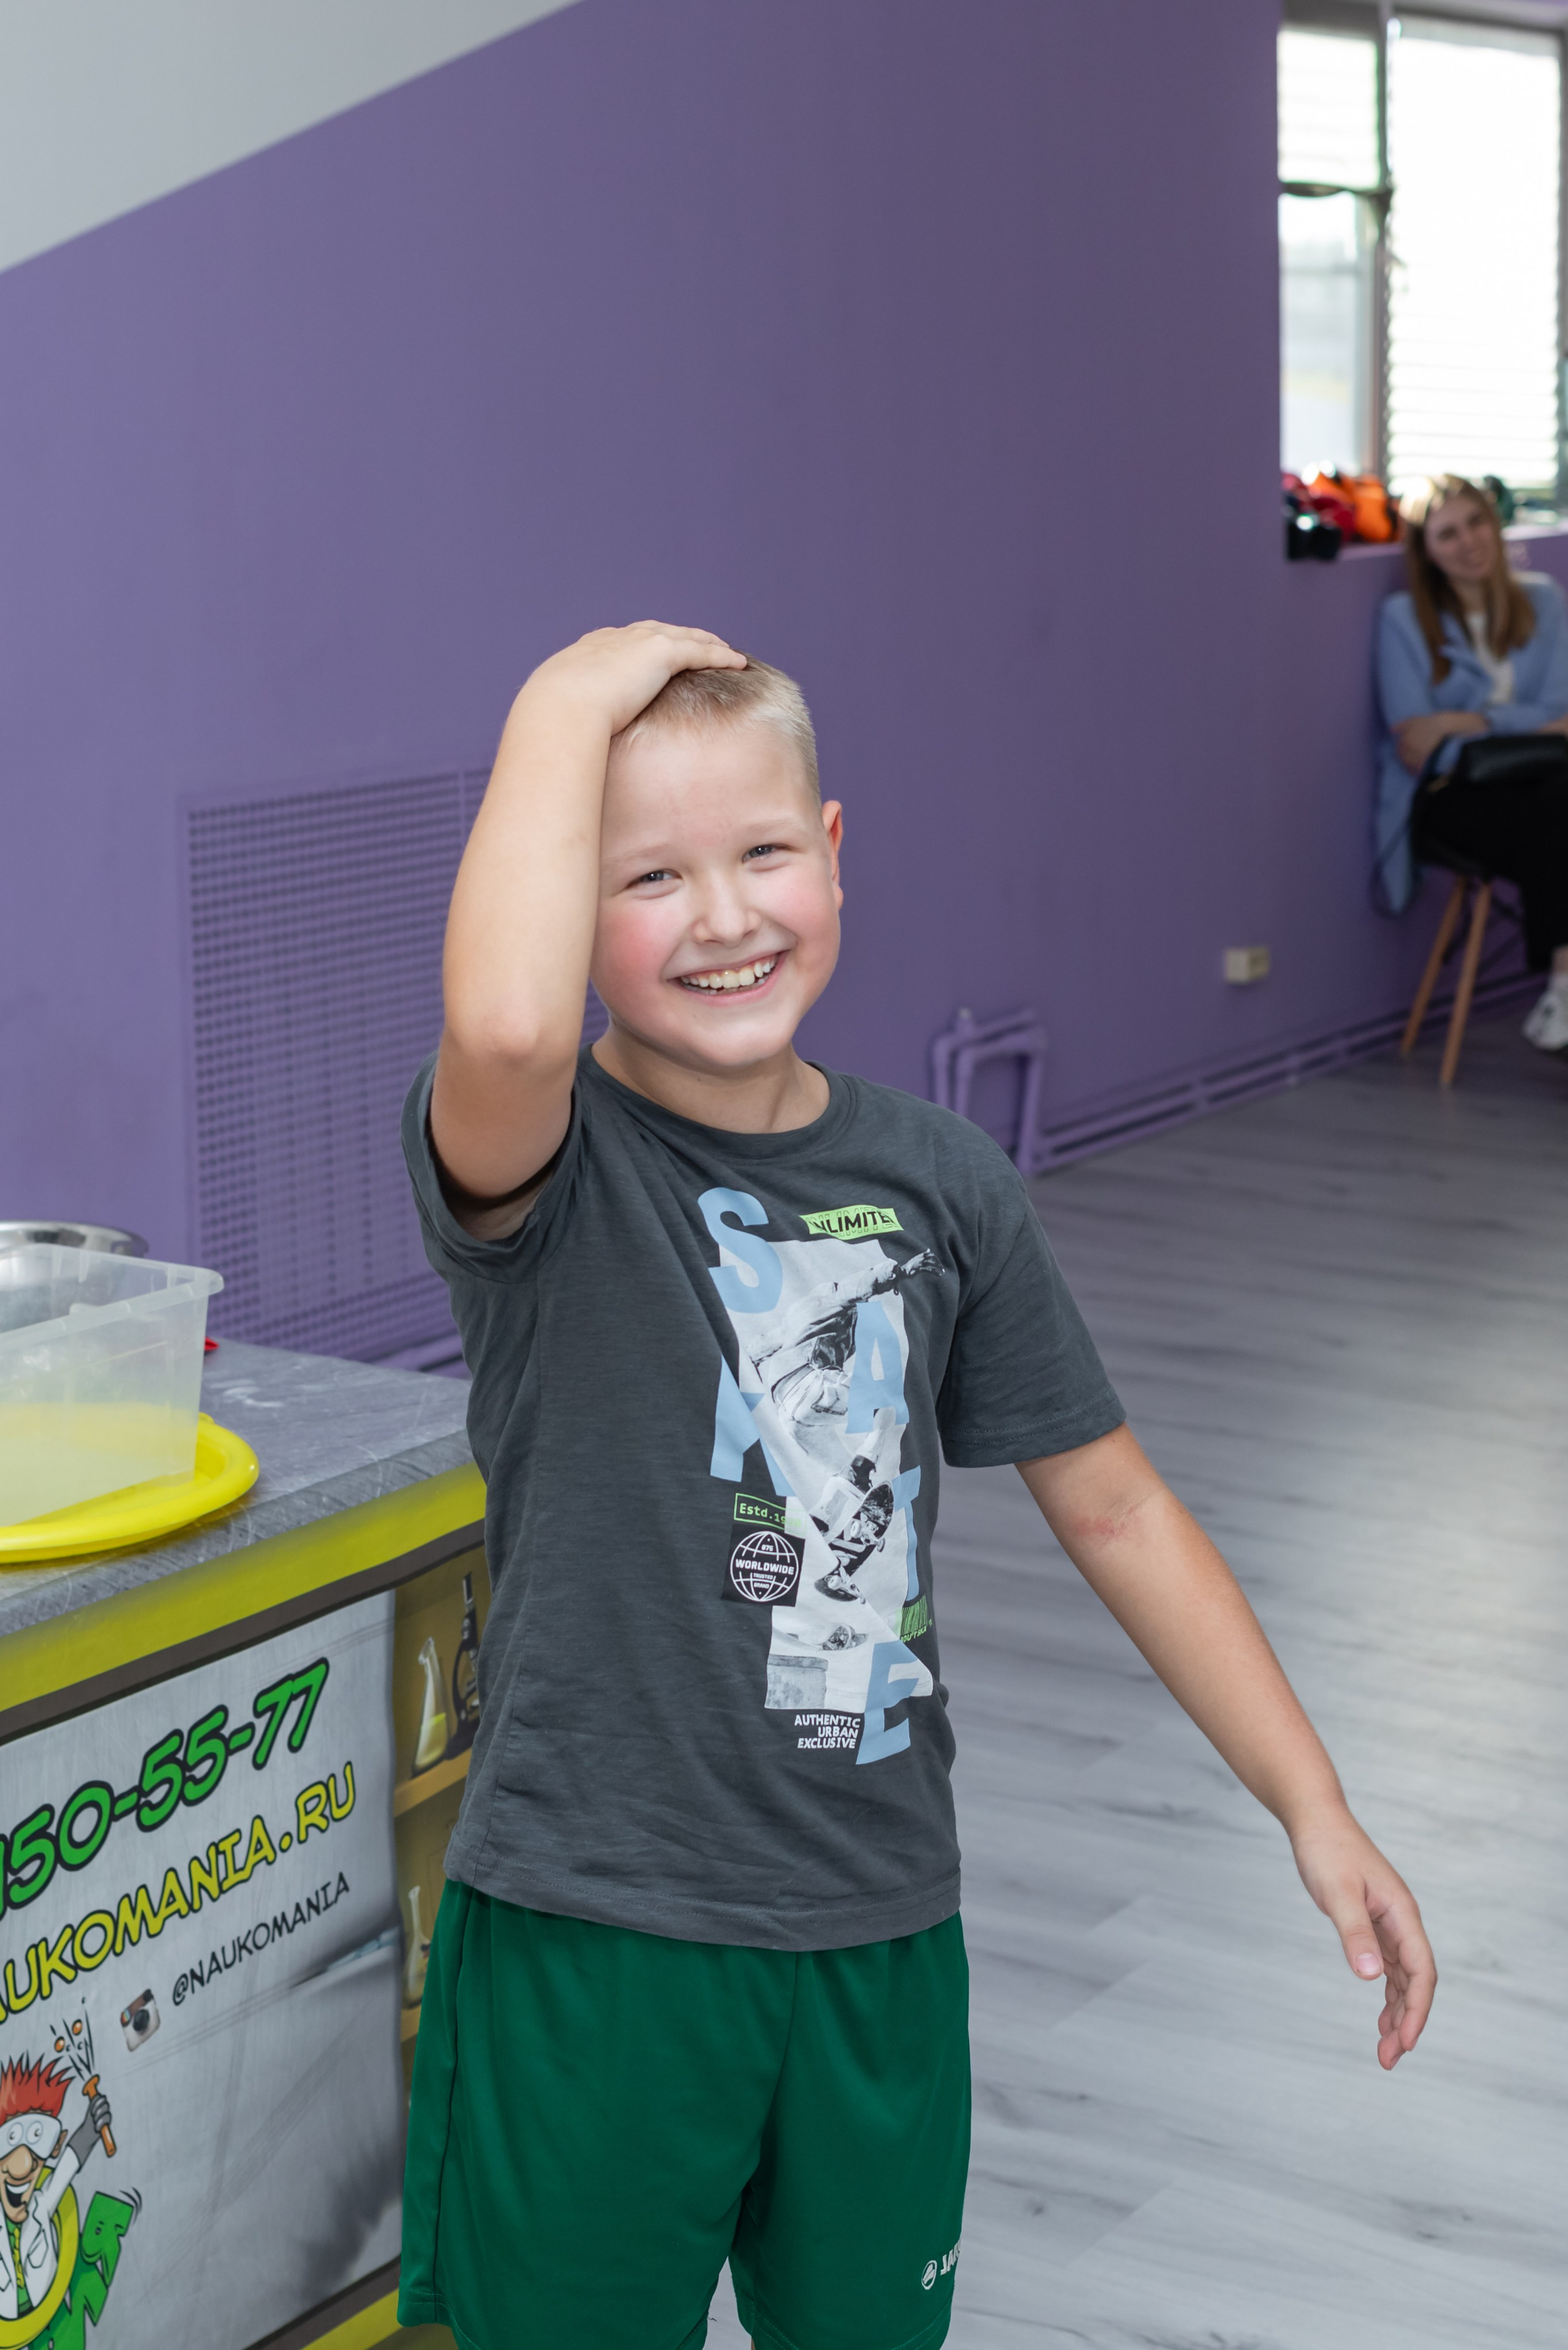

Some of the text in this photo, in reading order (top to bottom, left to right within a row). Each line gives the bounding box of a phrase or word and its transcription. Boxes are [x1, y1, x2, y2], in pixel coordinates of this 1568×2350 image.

[735, 1558, 795, 1575] WORLDWIDE
[794, 1714, 861, 1728] AUTHENTIC
[818, 1726, 859, 1739] URBAN
[797, 1737, 857, 1749] EXCLUSIVE
[0, 1761, 356, 2025] UKOMANIA.RU
[173, 1871, 350, 2006] @NAUKOMANIA
